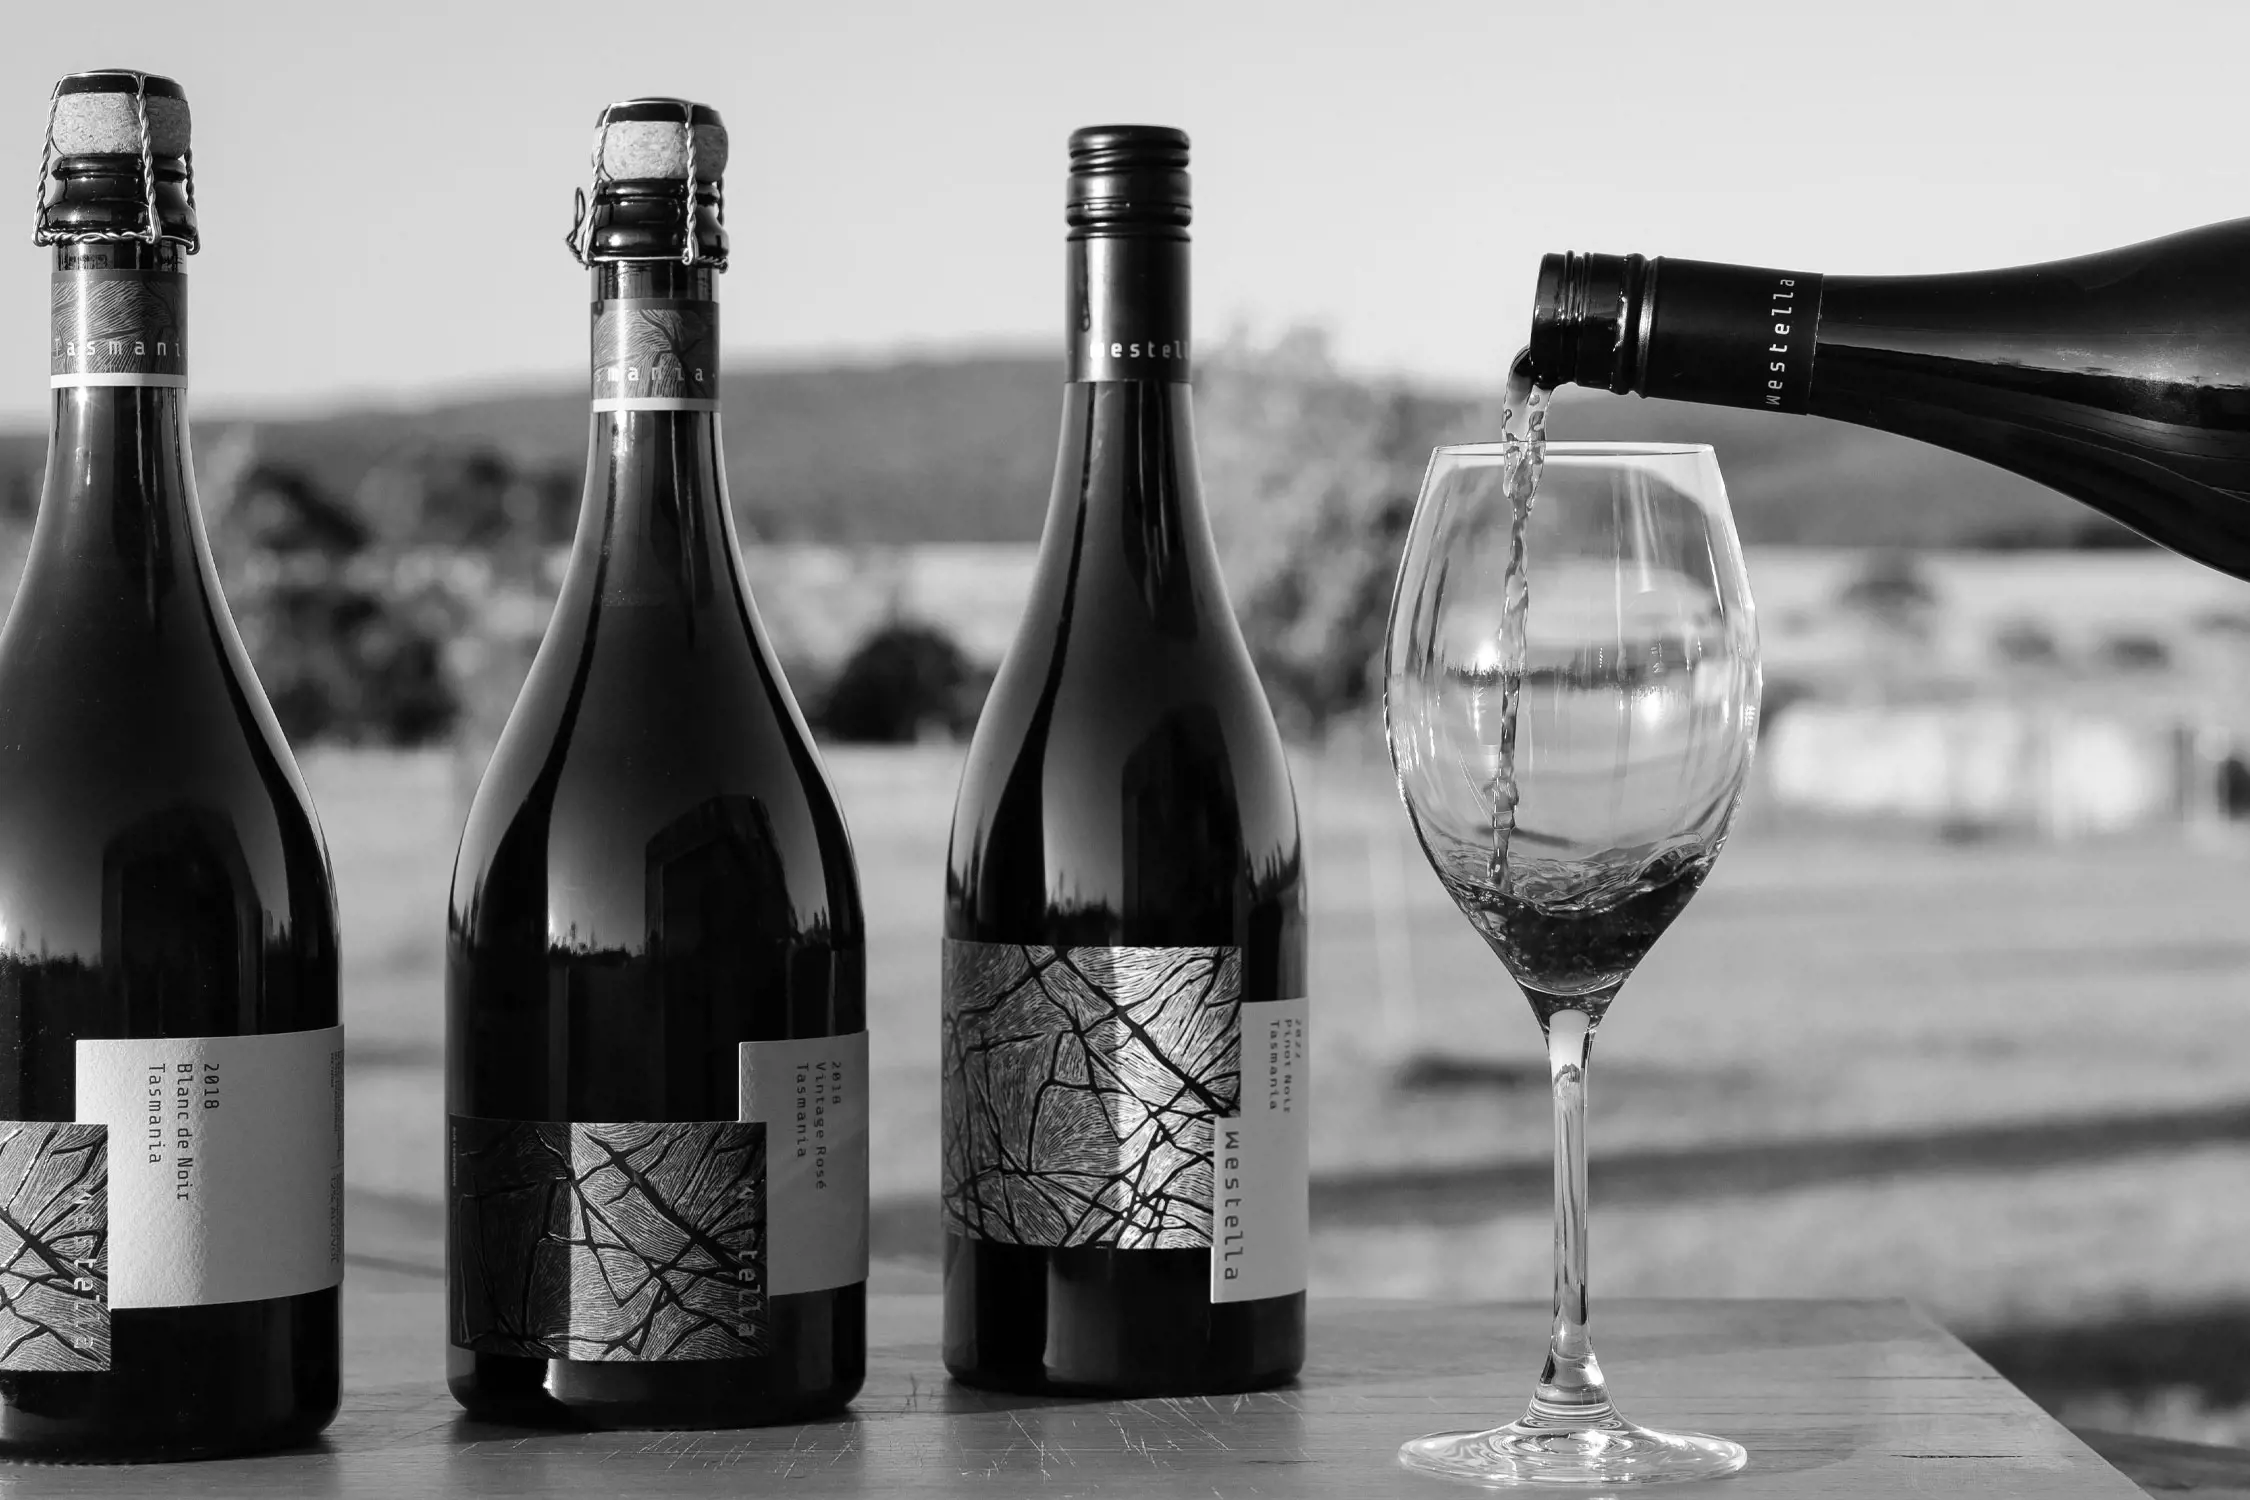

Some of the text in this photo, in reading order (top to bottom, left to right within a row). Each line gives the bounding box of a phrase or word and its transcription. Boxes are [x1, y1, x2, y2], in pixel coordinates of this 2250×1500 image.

[1765, 279, 1795, 406] westella
[204, 1063, 220, 1110] 2018
[831, 1061, 842, 1105] 2018
[1269, 1019, 1280, 1110] Tasmania
[1283, 1018, 1293, 1068] Pinot
[149, 1063, 166, 1164] Tasmania
[177, 1063, 193, 1201] Blanc de Noir
[797, 1062, 809, 1158] Tasmania
[814, 1061, 828, 1190] Vintage Rosé
[1224, 1131, 1244, 1281] westella
